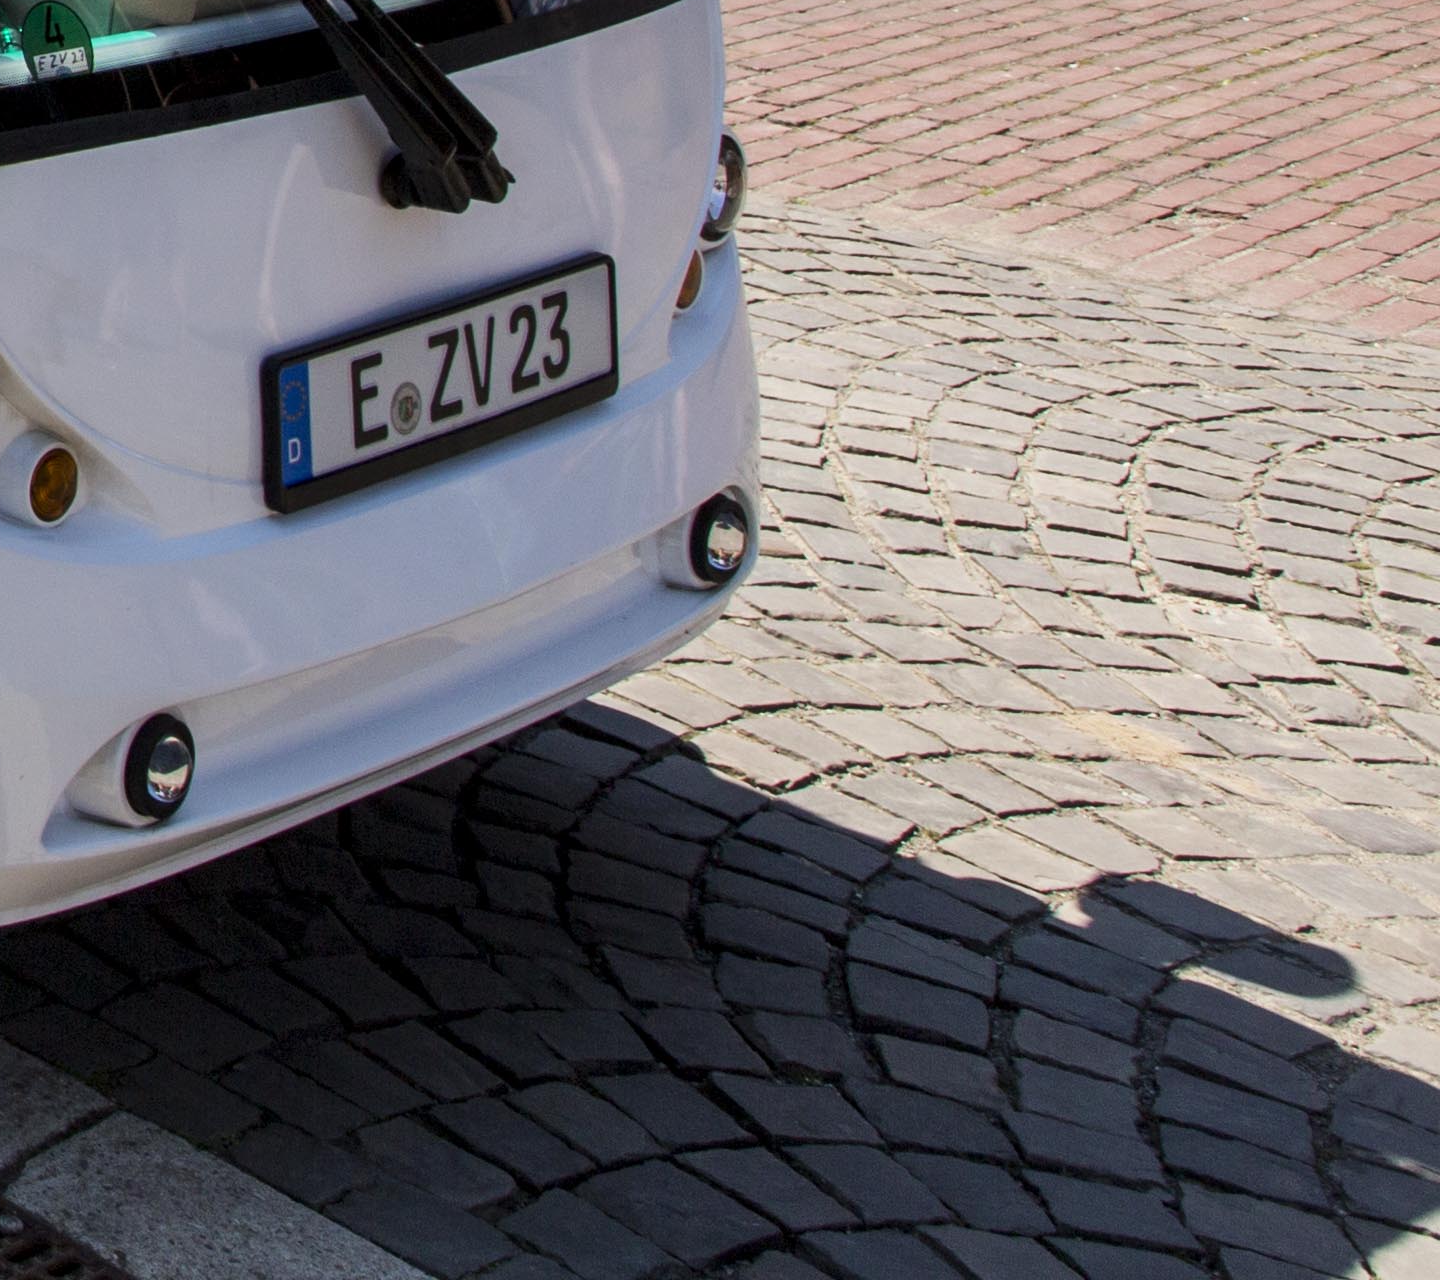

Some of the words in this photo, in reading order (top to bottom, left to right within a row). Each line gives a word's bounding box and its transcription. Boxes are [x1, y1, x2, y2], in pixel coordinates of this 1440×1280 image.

[46, 5, 65, 47] 4
[288, 437, 302, 464] D
[351, 352, 389, 450] E
[427, 315, 495, 424] ZV
[509, 290, 571, 395] 23
